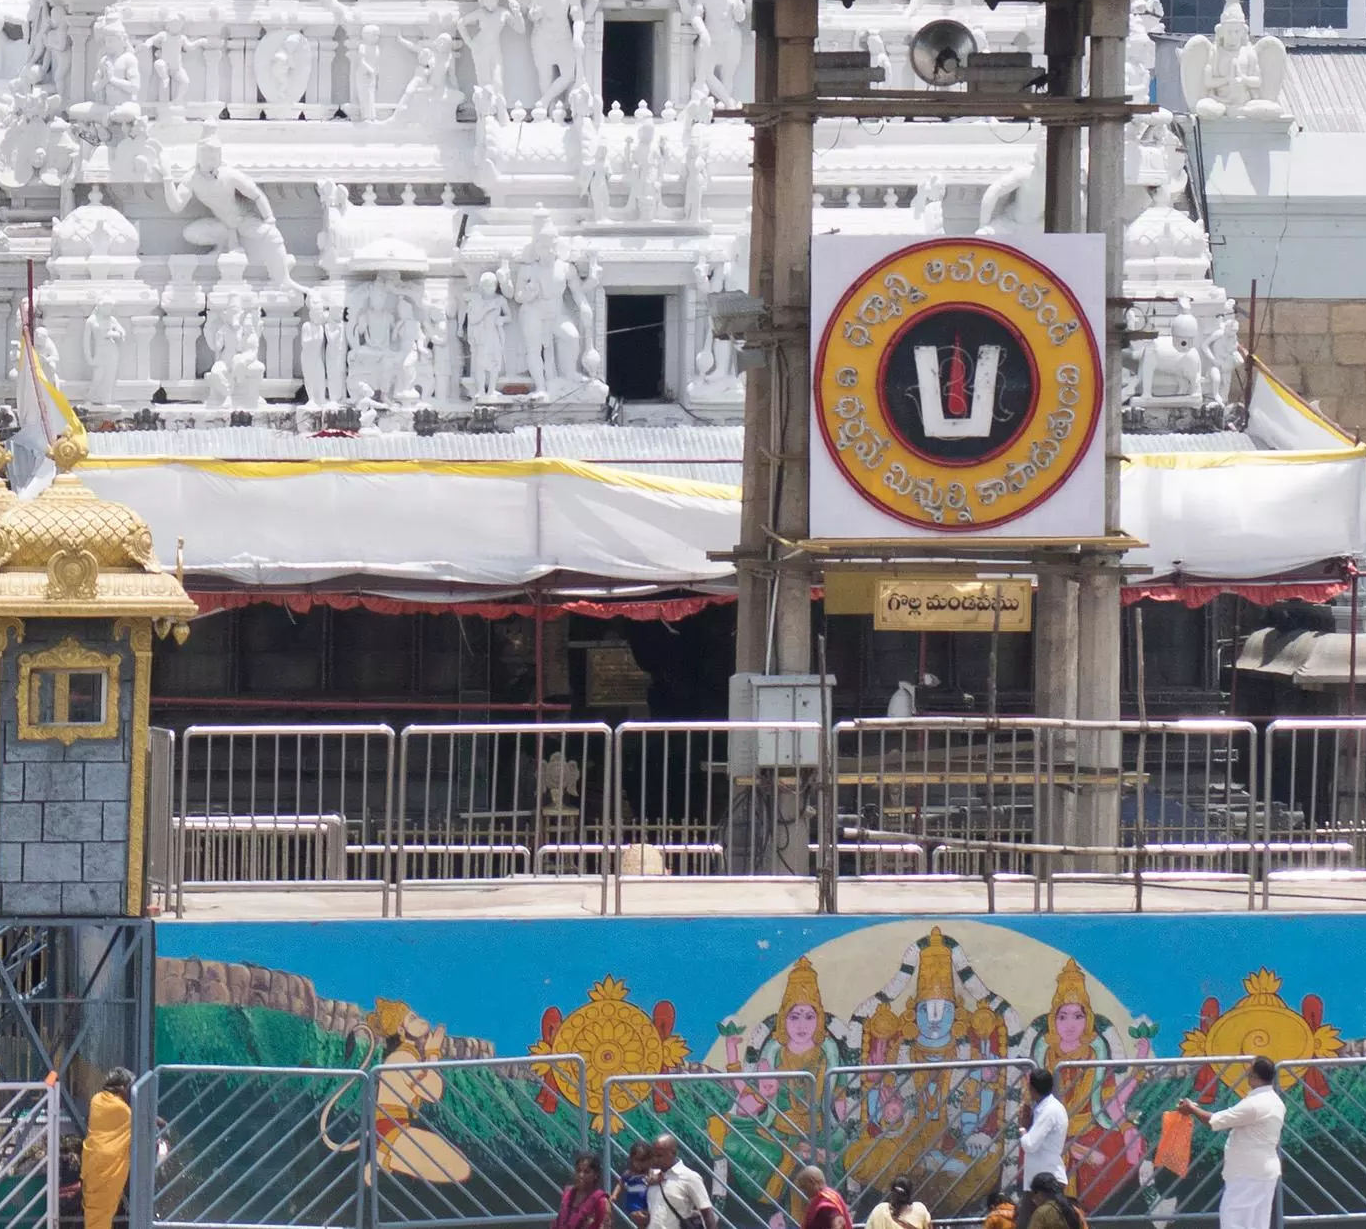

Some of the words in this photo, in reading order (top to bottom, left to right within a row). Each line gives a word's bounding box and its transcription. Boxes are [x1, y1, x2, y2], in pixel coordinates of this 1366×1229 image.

[843, 272, 928, 347] ధర్మాన్ని
[924, 252, 1080, 346] ఆచరించండి
[836, 365, 859, 387] ఆ
[832, 395, 891, 469] ధర్మమే
[975, 363, 1080, 505] కాపాడుతుంది
[883, 462, 974, 523] మిమ్మల్ని
[887, 593, 922, 616] గొల్ల
[926, 594, 1020, 611] మండపము
